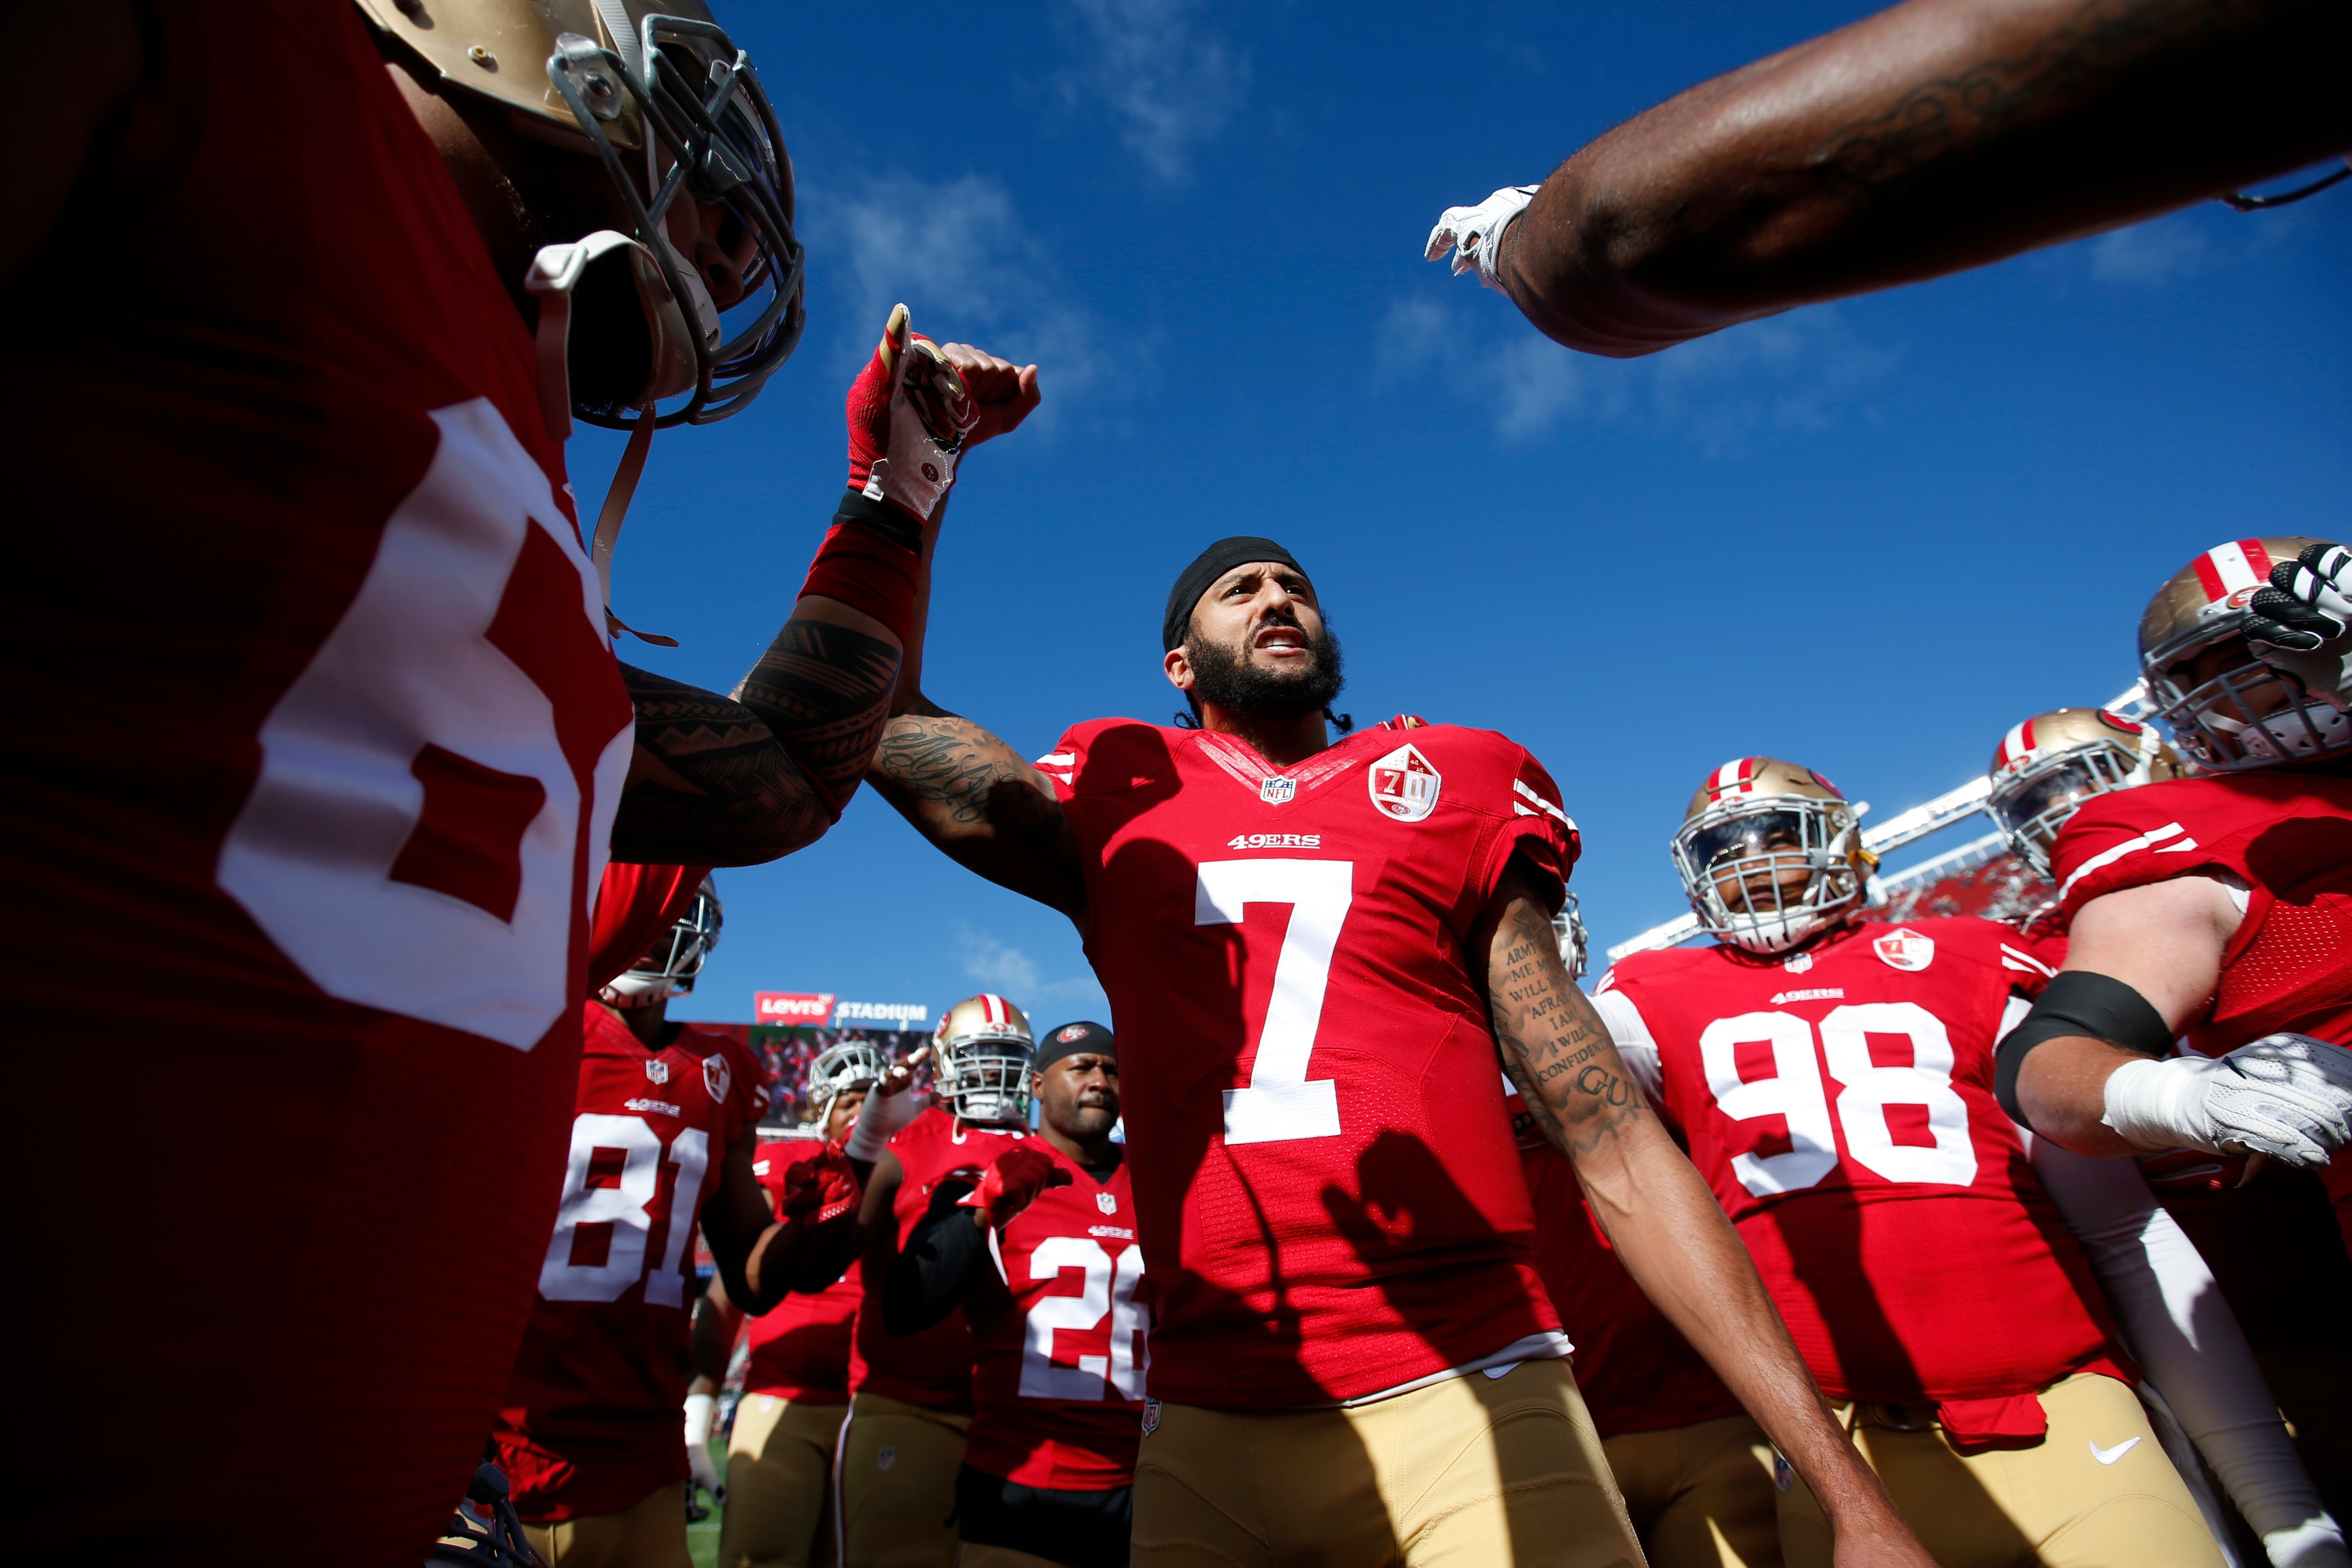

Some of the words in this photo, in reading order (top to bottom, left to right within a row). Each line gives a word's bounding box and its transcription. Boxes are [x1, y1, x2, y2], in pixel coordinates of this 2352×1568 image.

[214, 396, 635, 1052] 6
[1266, 788, 1289, 799] NFL
[1383, 770, 1427, 800] 70
[1227, 834, 1321, 850] 49ERS
[1506, 941, 1538, 966] ARMY
[1511, 963, 1534, 982] ME
[1195, 858, 1354, 1146] 7
[1509, 980, 1548, 1002] WILL
[1770, 988, 1846, 1005] 49ERS
[836, 1001, 928, 1021] STADIUM
[1558, 1026, 1589, 1048] WILL
[1699, 1001, 1979, 1198] 98
[538, 1112, 710, 1309] 81
